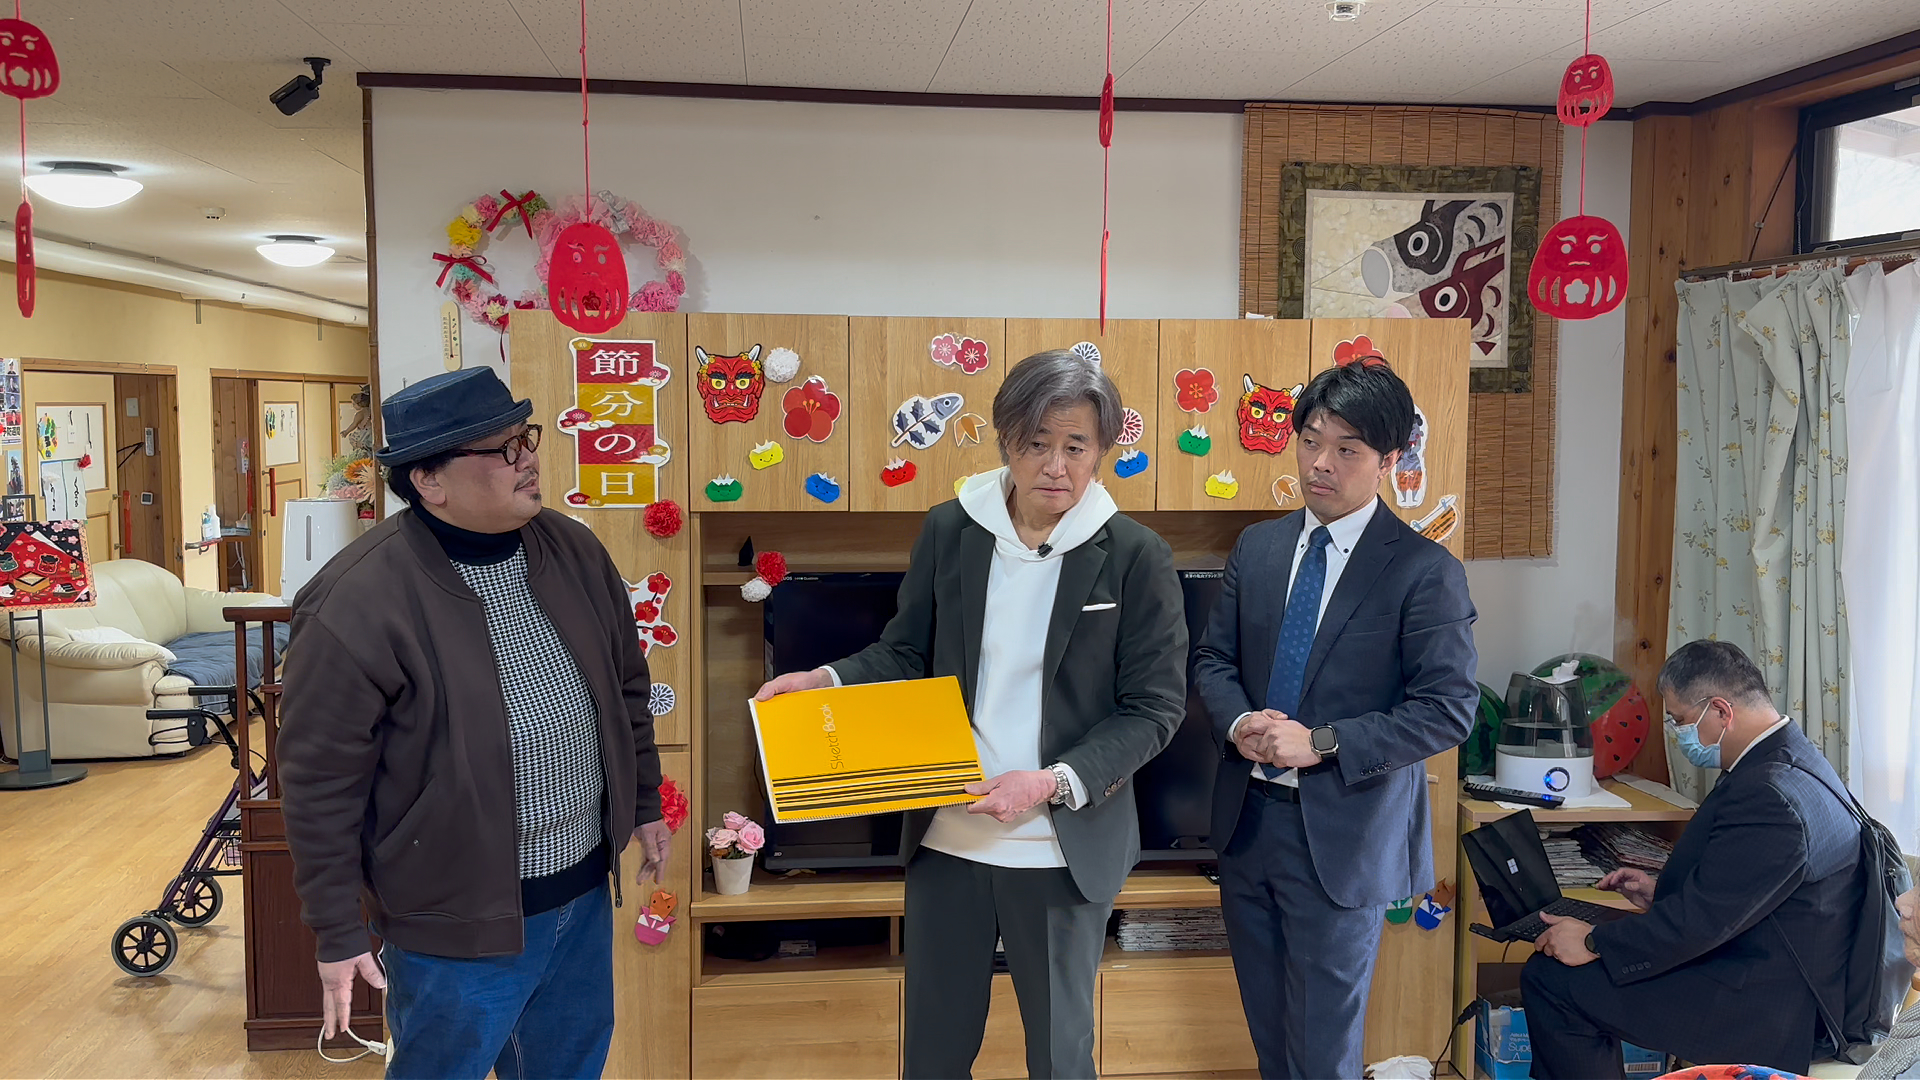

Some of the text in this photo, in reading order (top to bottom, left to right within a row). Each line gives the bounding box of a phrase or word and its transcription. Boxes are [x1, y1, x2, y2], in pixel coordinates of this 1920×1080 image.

[589, 349, 644, 496] 節分の日
[818, 703, 845, 770] SketchBook
